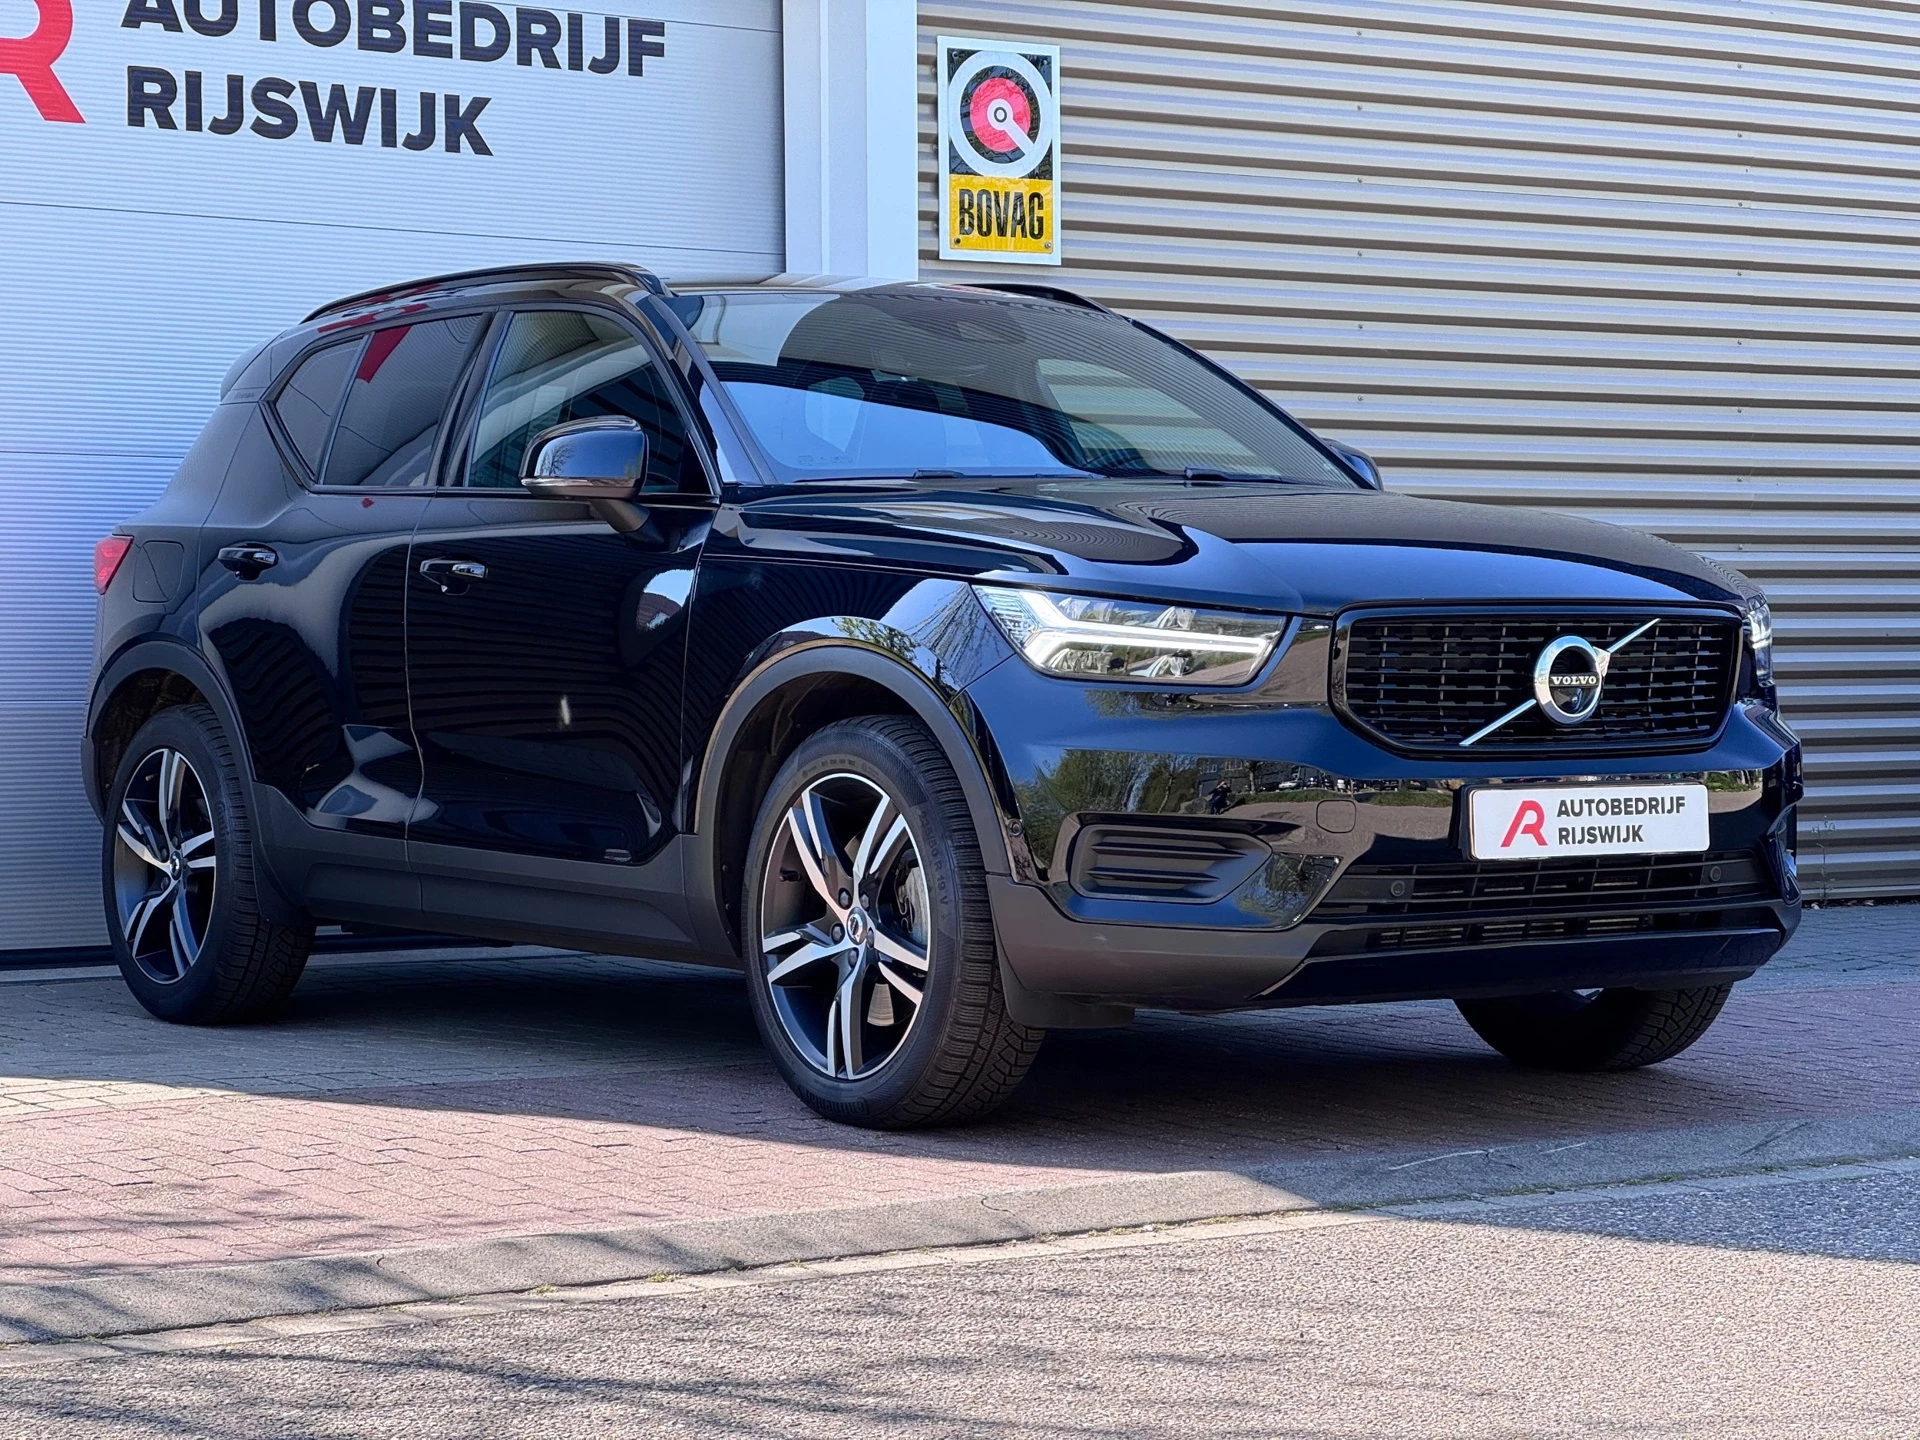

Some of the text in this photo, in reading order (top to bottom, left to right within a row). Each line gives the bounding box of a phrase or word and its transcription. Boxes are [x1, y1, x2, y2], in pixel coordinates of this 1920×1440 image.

[127, 65, 494, 157] RIJSWIJK
[959, 188, 1044, 240] BOVAG
[1551, 675, 1597, 685] VOLVO
[1556, 796, 1686, 818] AUTOBEDRIJF
[1558, 824, 1644, 845] RIJSWIJK
